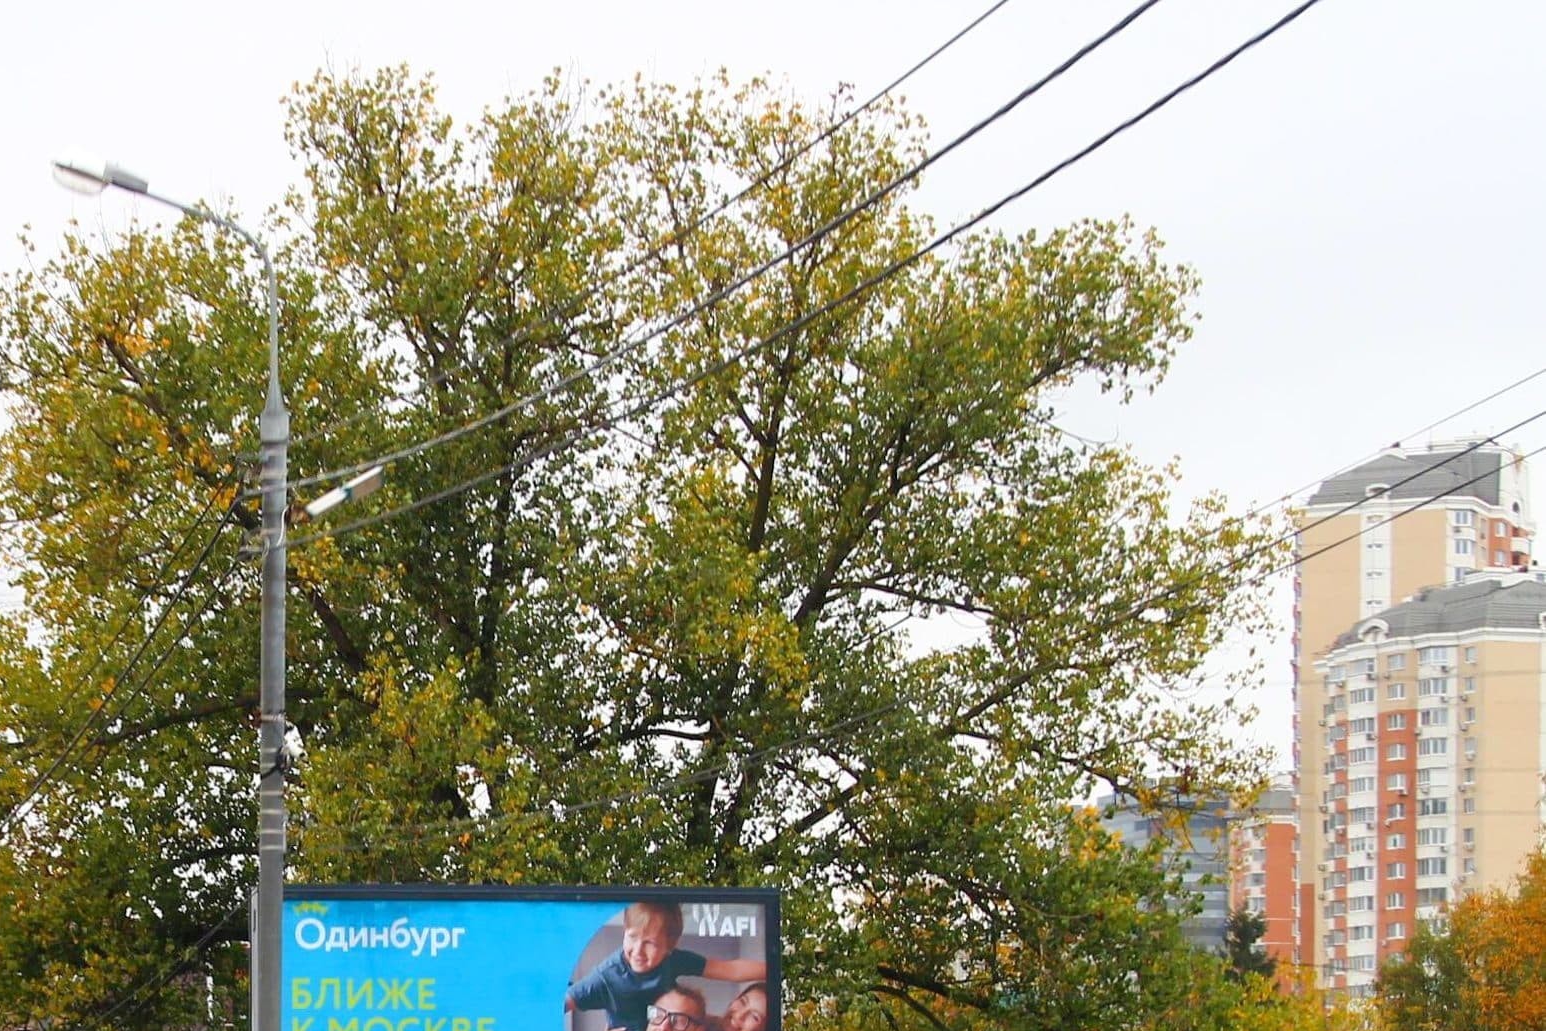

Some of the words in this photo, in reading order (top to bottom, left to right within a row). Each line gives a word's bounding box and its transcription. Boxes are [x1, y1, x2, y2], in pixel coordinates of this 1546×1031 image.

[295, 917, 465, 957] Одинбург
[719, 915, 757, 937] AFI
[292, 977, 437, 1010] БЛИЖЕ
